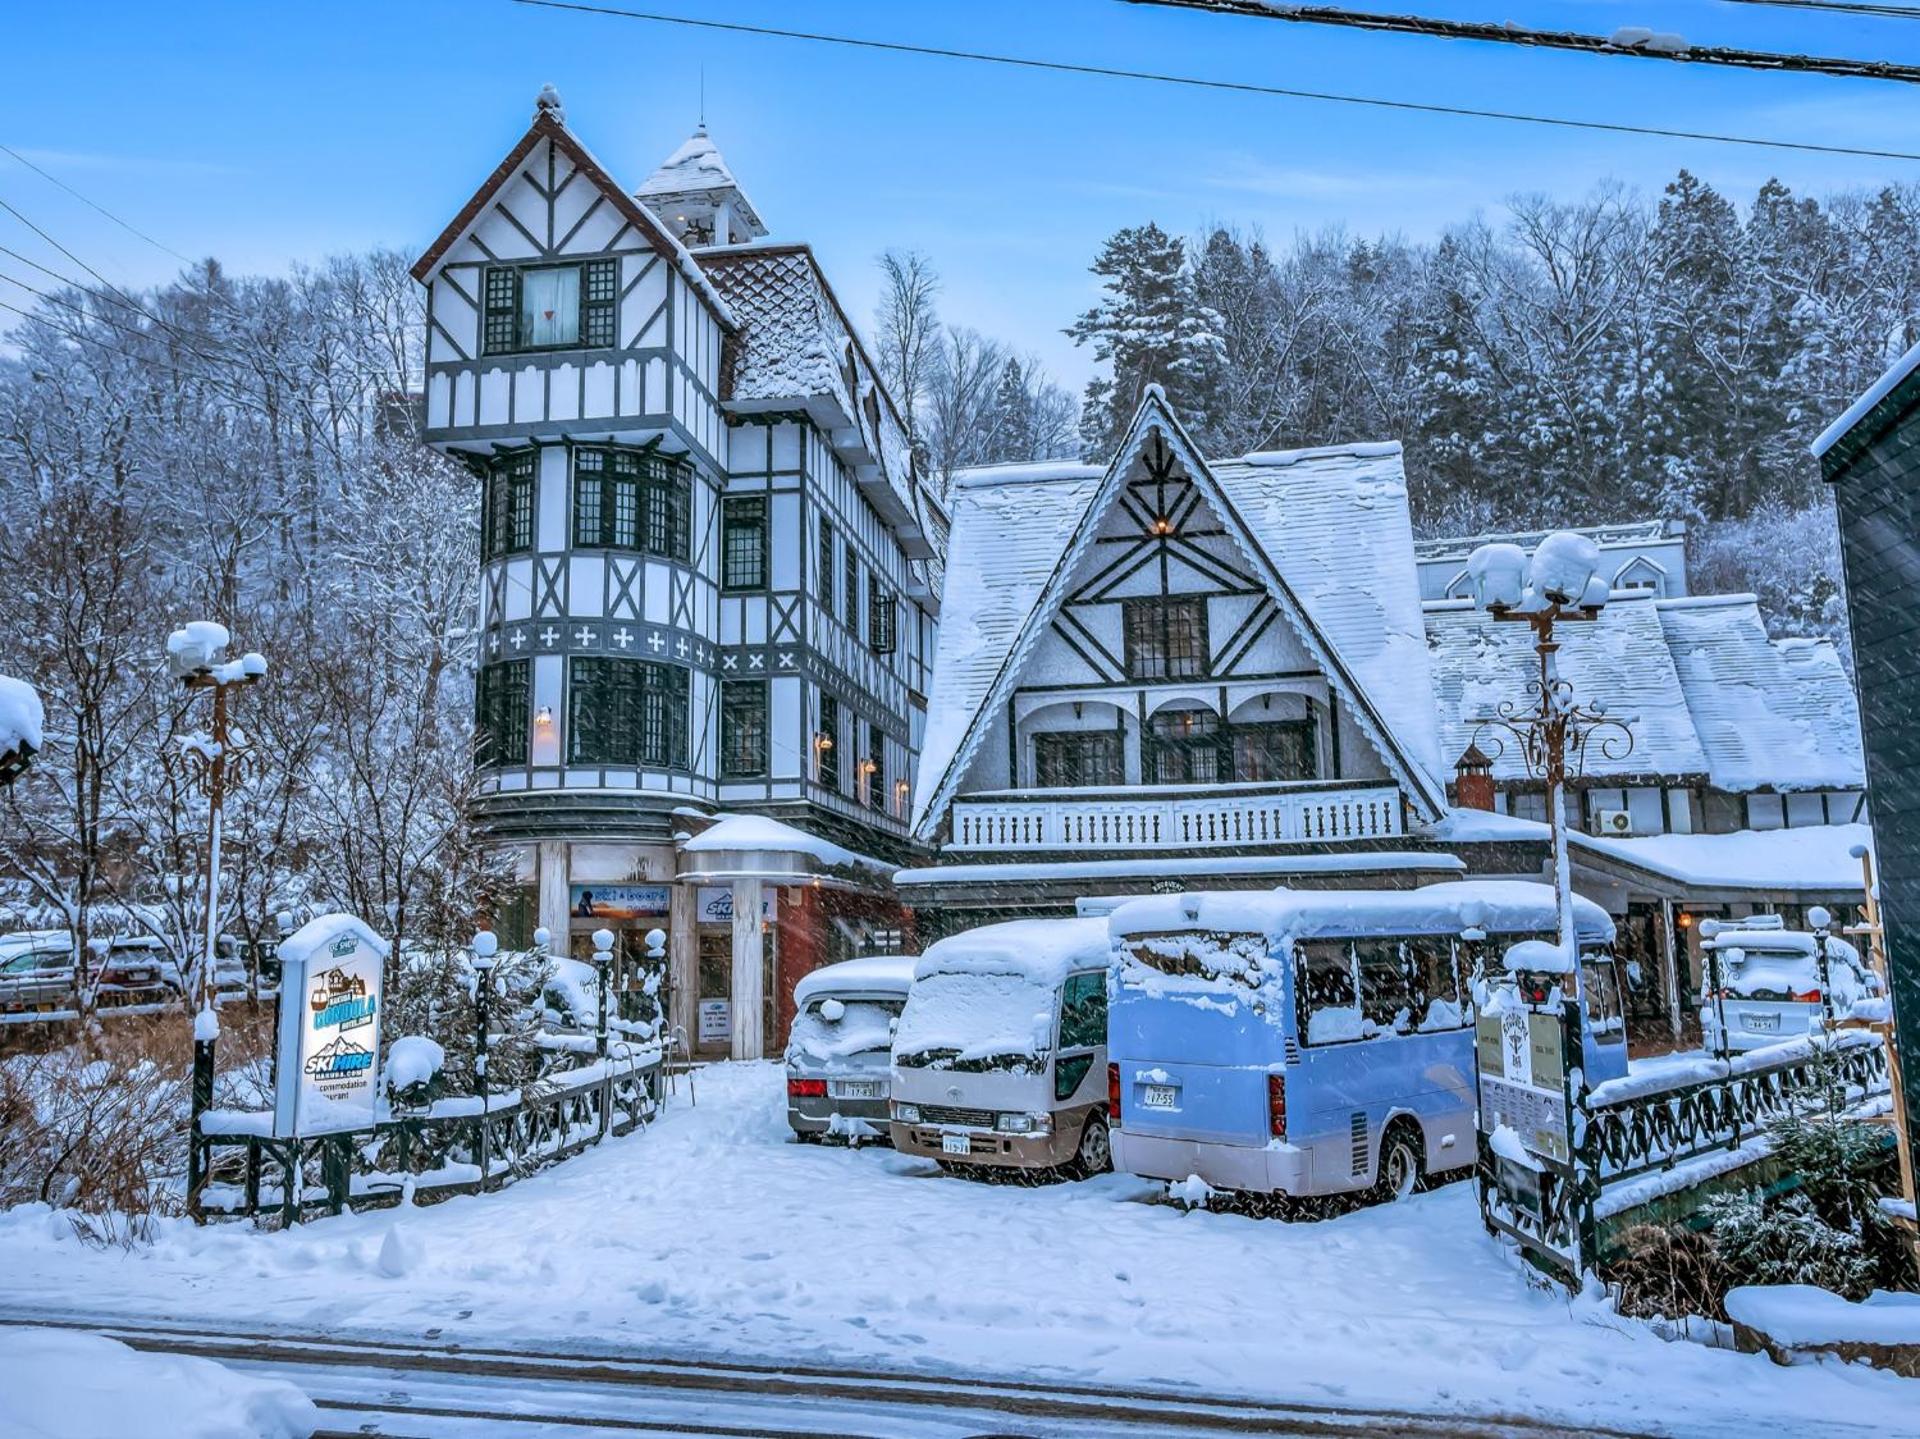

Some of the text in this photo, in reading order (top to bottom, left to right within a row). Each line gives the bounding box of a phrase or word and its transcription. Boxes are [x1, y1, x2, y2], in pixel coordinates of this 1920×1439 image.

[627, 886, 667, 901] board
[313, 994, 376, 1030] GONDOLA
[319, 1079, 367, 1092] commodation
